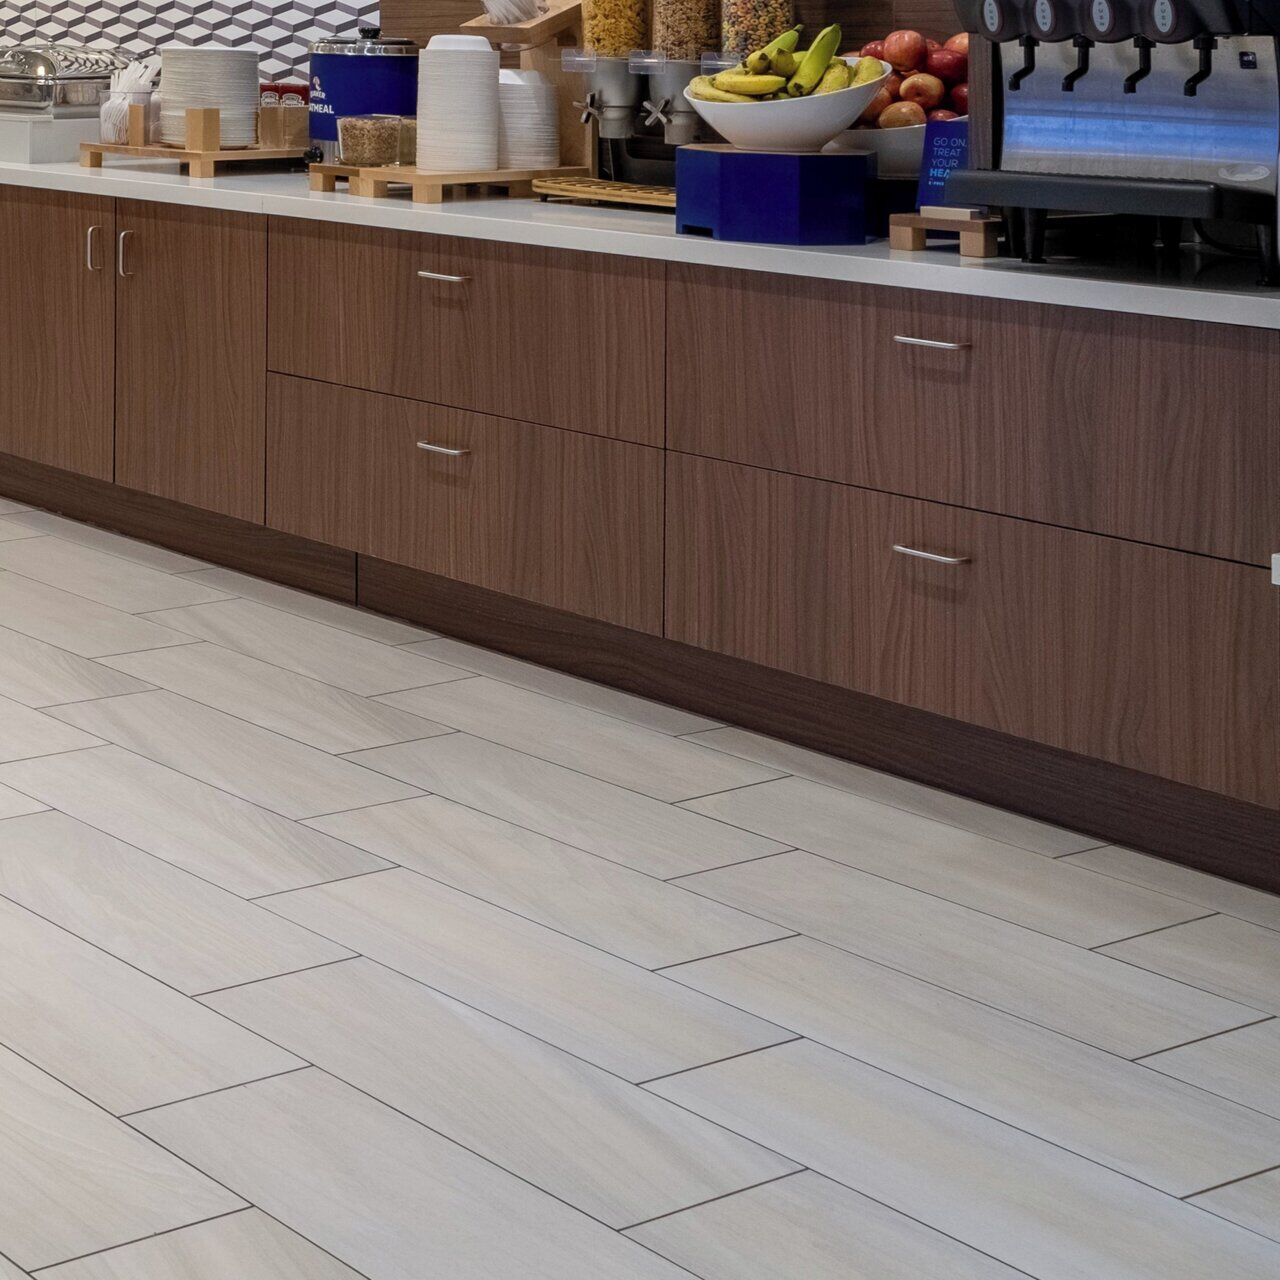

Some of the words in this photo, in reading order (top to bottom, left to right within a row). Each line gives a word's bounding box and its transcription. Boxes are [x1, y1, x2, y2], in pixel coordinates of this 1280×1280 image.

[309, 102, 335, 114] ATMEAL
[933, 137, 948, 146] GO
[933, 147, 961, 157] TREAT
[931, 158, 959, 168] YOUR
